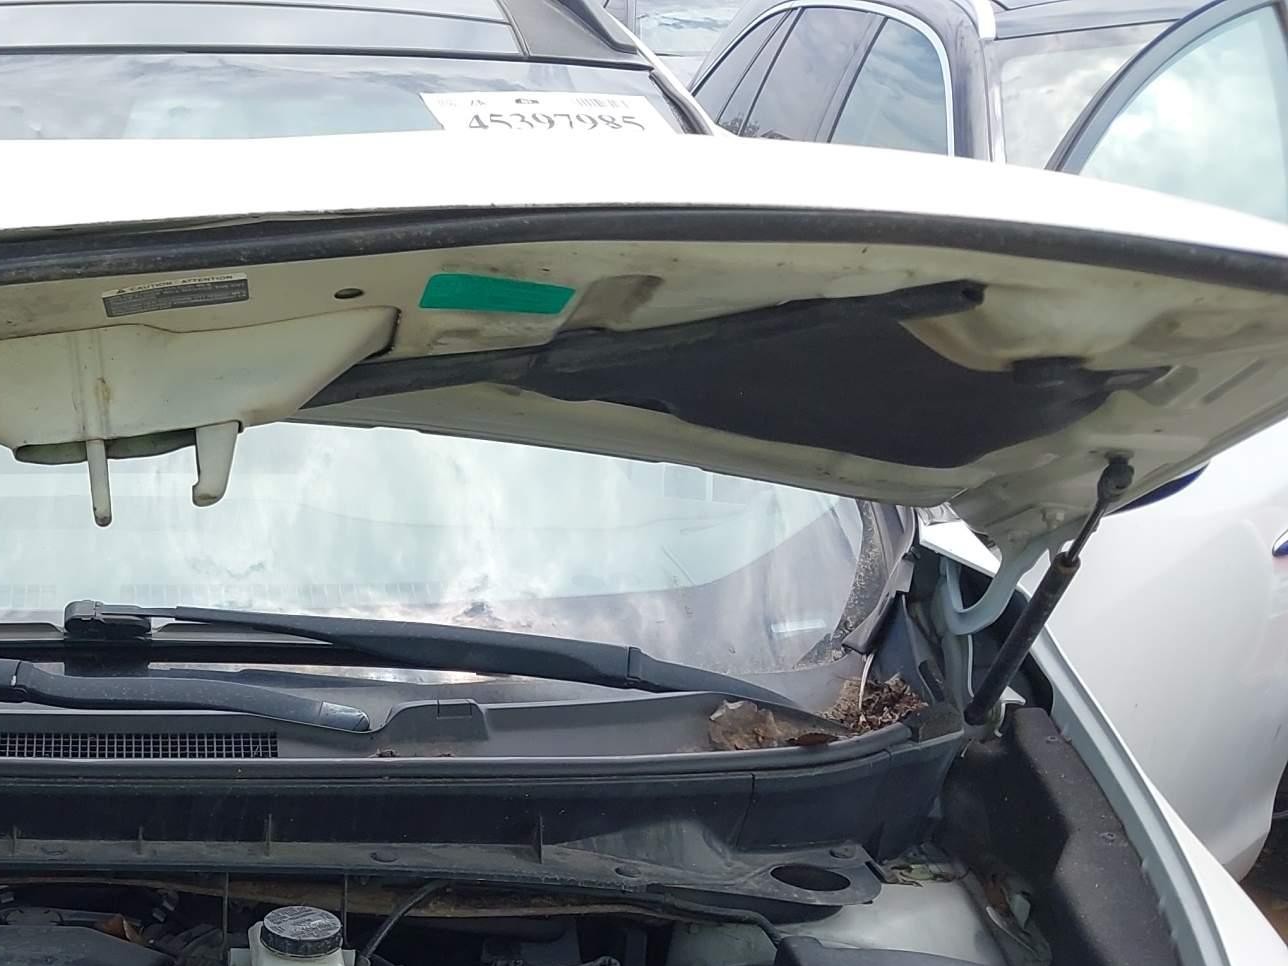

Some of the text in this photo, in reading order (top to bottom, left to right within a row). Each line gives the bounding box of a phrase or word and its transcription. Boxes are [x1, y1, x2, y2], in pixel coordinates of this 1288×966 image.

[468, 113, 646, 131] 45397985
[129, 281, 173, 291] CAUTION
[181, 275, 233, 284] ATTENTION
